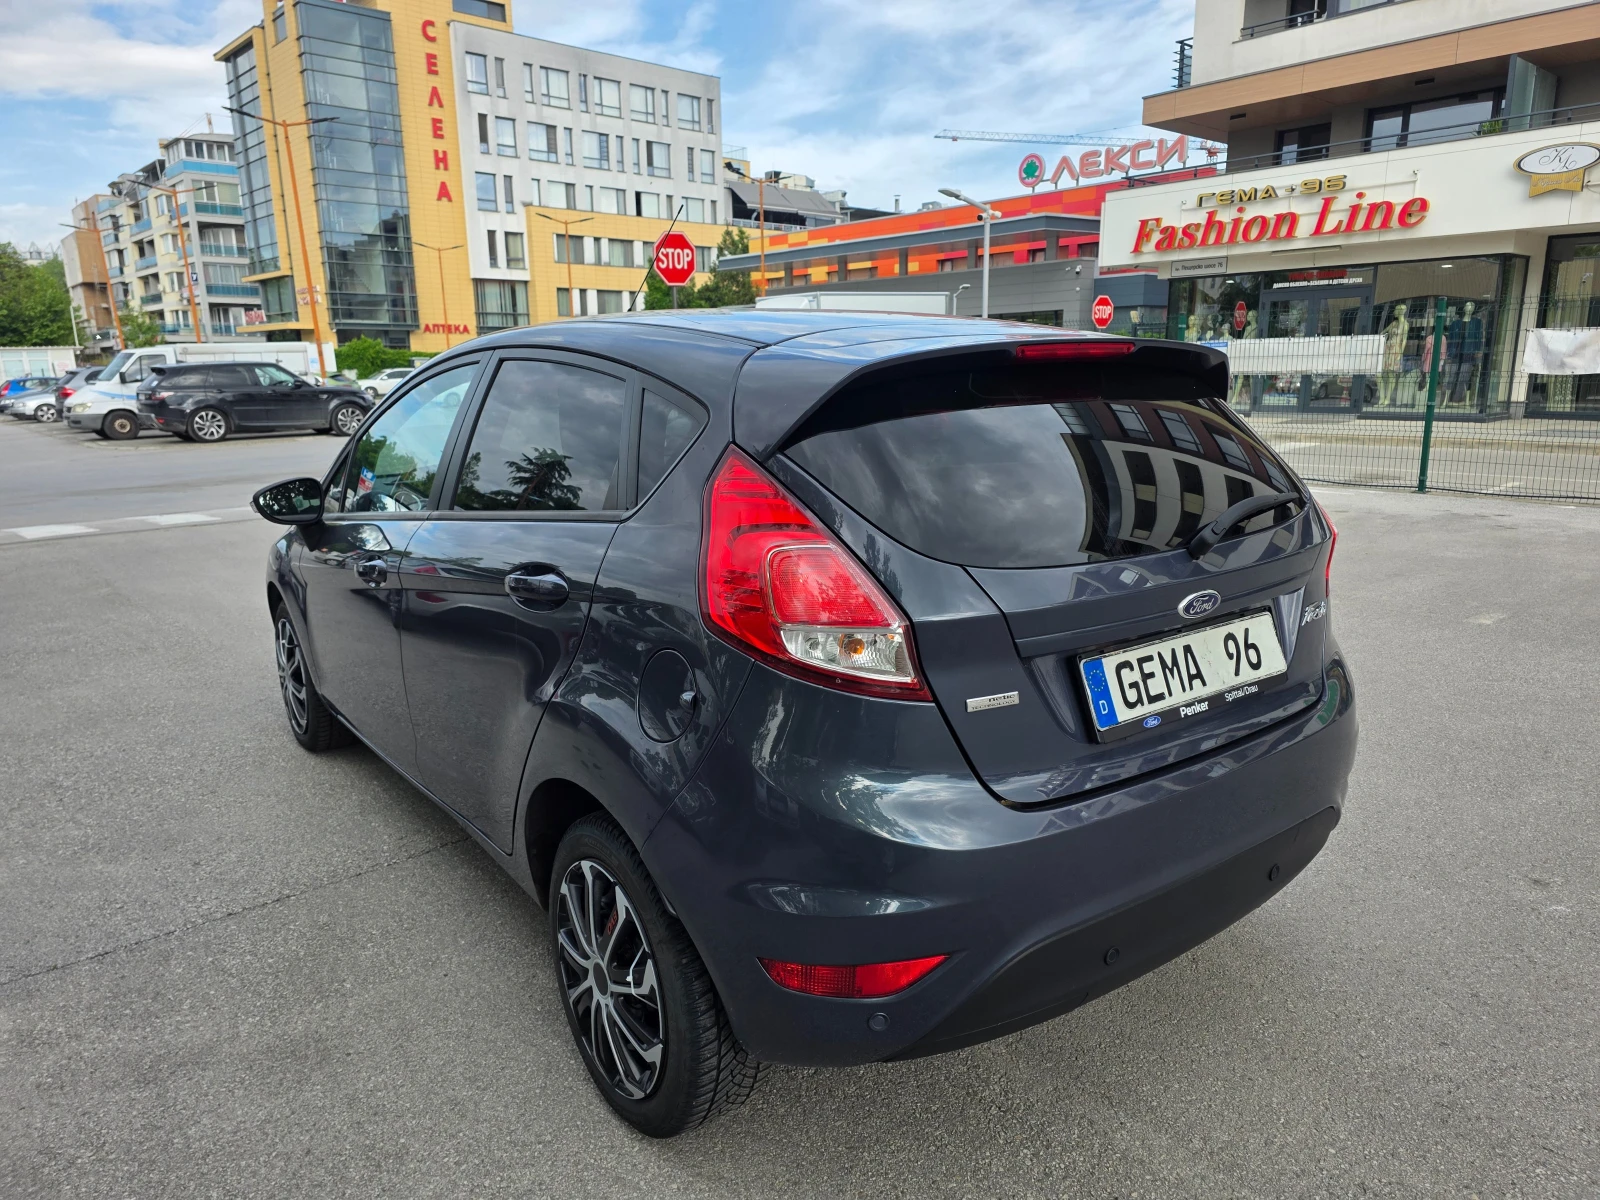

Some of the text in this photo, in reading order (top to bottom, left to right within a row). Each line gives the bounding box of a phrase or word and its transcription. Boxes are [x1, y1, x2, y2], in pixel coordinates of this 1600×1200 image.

[421, 19, 453, 203] СЕЛЕНА
[1050, 134, 1189, 184] ЛЕКСИ
[1130, 191, 1430, 254] Fashion Line
[658, 248, 693, 270] STOP
[1094, 307, 1112, 319] STOP
[423, 323, 470, 334] АПТЕКА
[1189, 595, 1214, 614] Ford
[1115, 627, 1262, 710] GEMA 96
[1099, 699, 1109, 715] D
[1179, 700, 1209, 718] Penker
